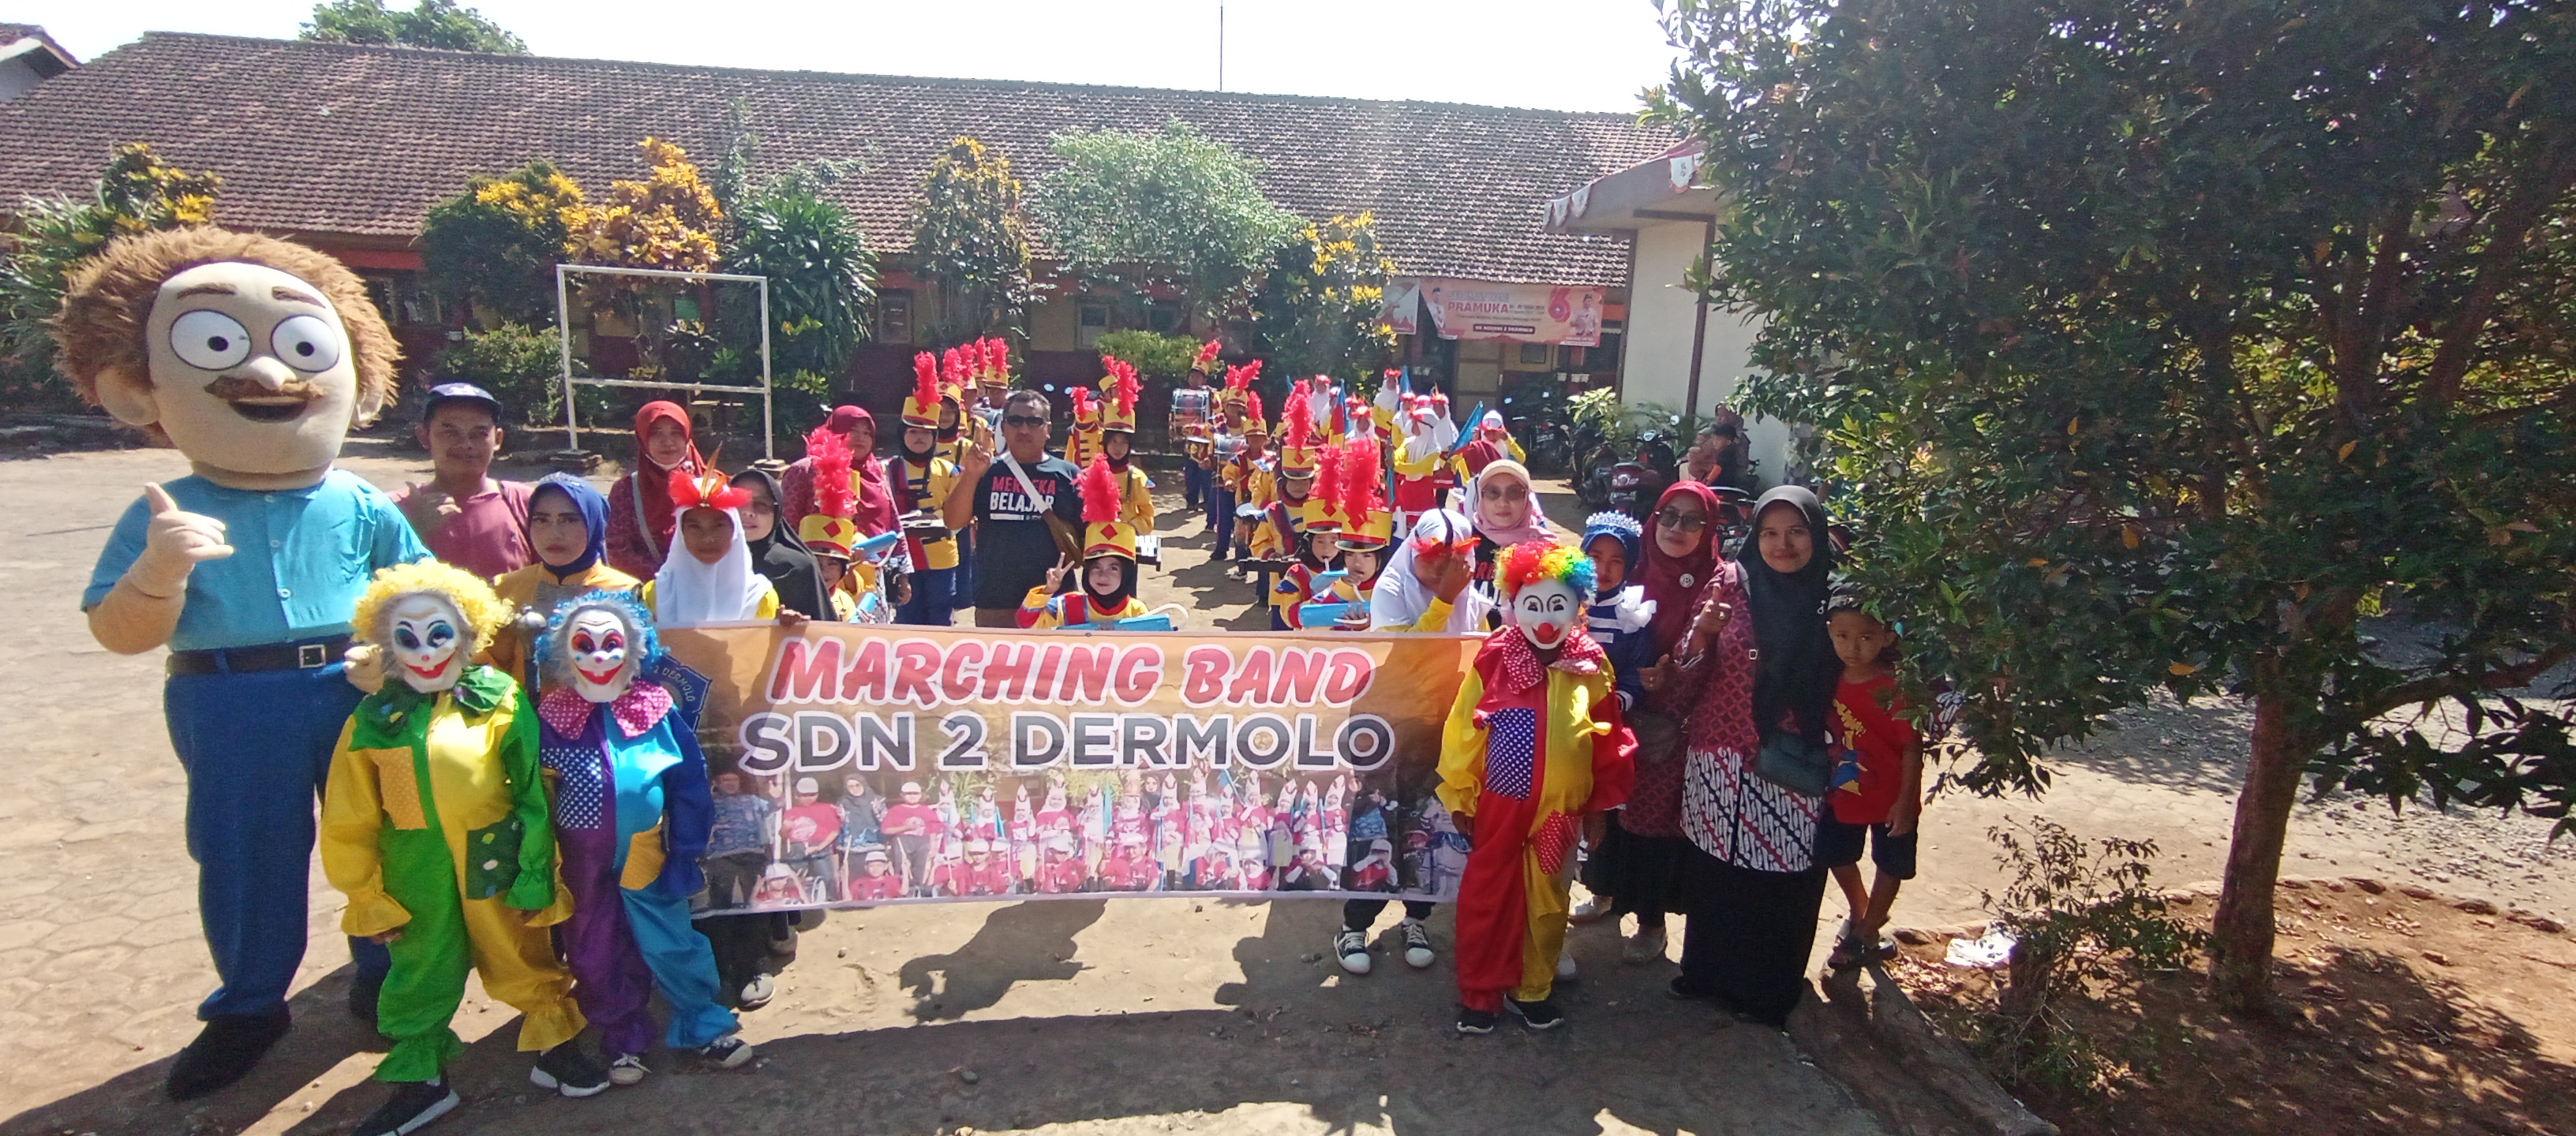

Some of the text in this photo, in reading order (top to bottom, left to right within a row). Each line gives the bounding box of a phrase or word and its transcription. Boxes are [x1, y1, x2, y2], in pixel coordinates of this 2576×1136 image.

[1447, 301, 1508, 313] PRAMUKA
[991, 476, 1056, 495] MEREKA
[661, 666, 696, 703] DERMOLO
[769, 640, 1373, 706] MARCHING BAND
[742, 714, 1391, 770] SDN 2 DERMOLO
